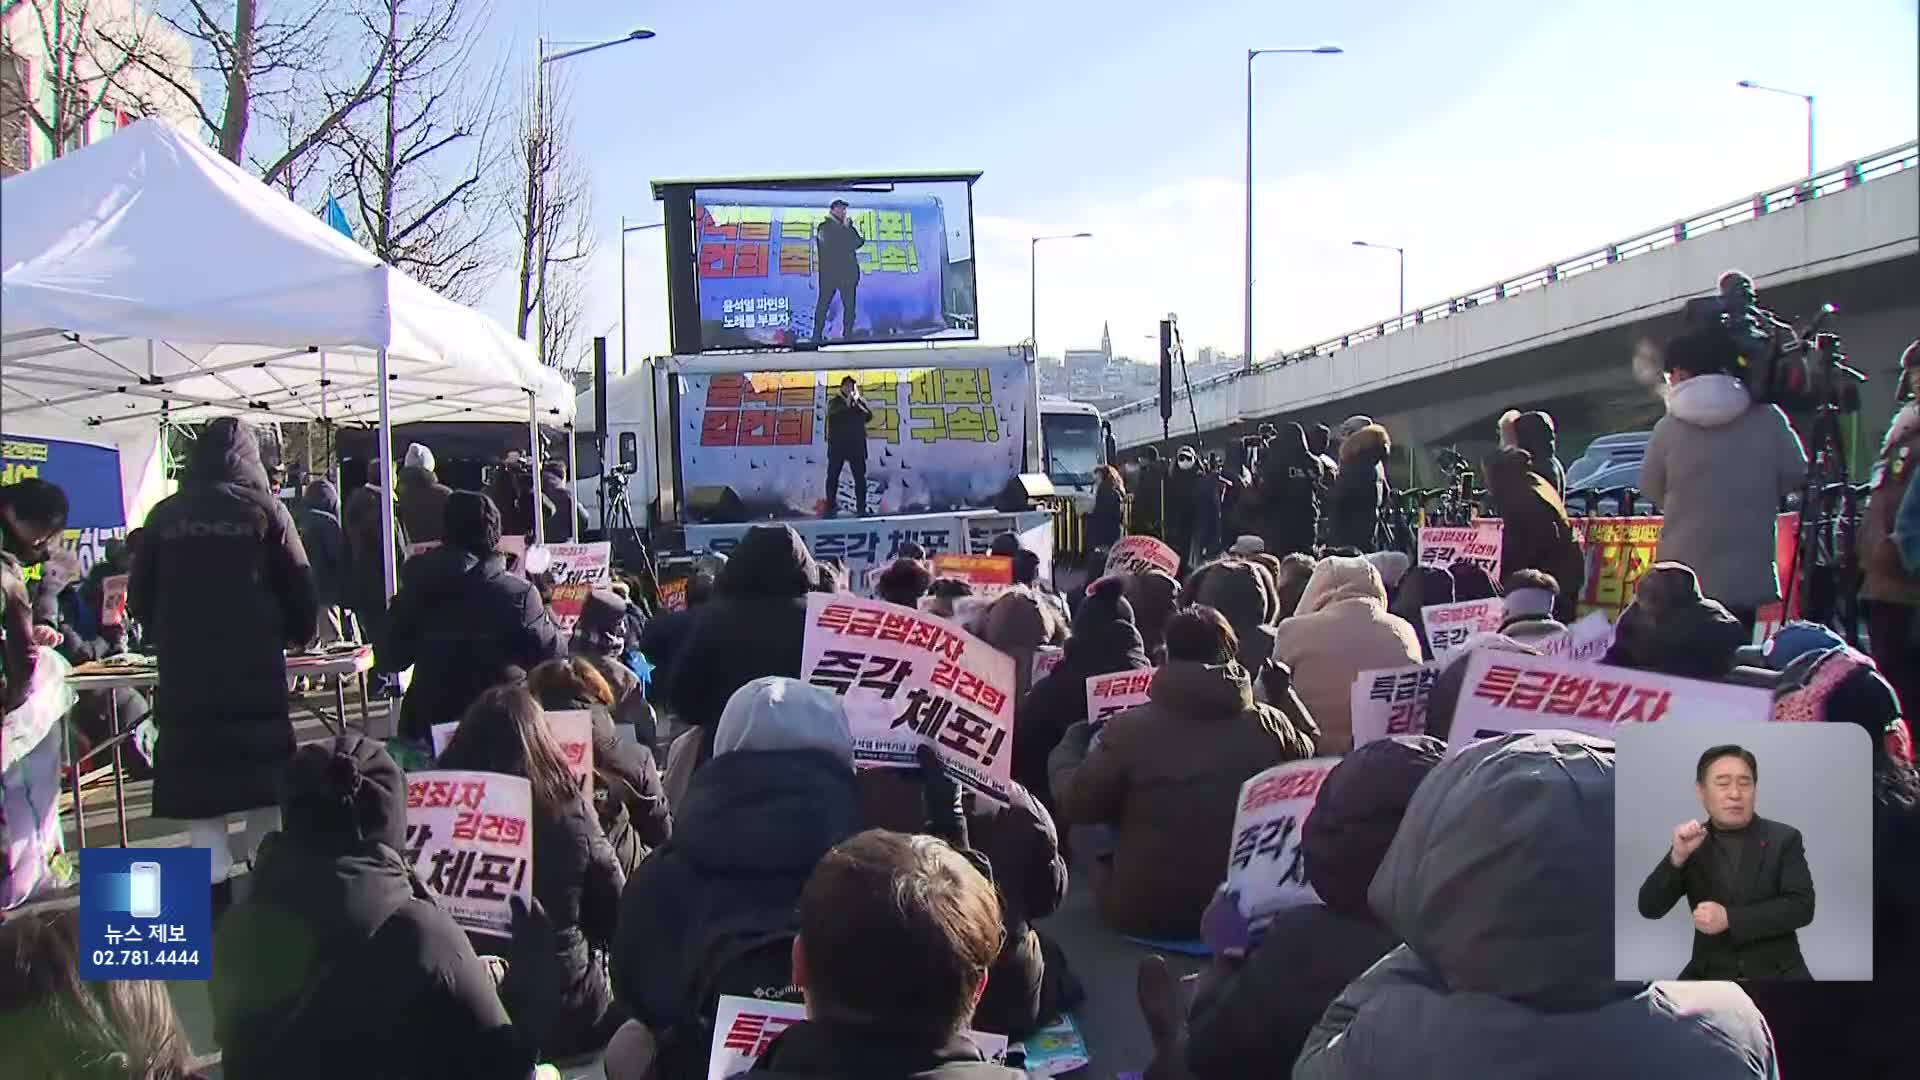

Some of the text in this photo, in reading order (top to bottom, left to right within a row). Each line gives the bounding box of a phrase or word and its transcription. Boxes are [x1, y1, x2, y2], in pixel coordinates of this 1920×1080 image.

[908, 368, 992, 405] 체포!
[911, 406, 999, 443] 구속!
[816, 603, 966, 661] 특급범죄자
[1432, 627, 1468, 650] 즉각
[809, 649, 1007, 767] 즉각 체포!
[930, 658, 1007, 716] 김건희
[1093, 674, 1152, 698] 특급범
[1474, 664, 1673, 722] 특급범죄자
[452, 812, 527, 846] 김건희
[1232, 816, 1297, 870] 즉각
[427, 849, 527, 902] 체포!
